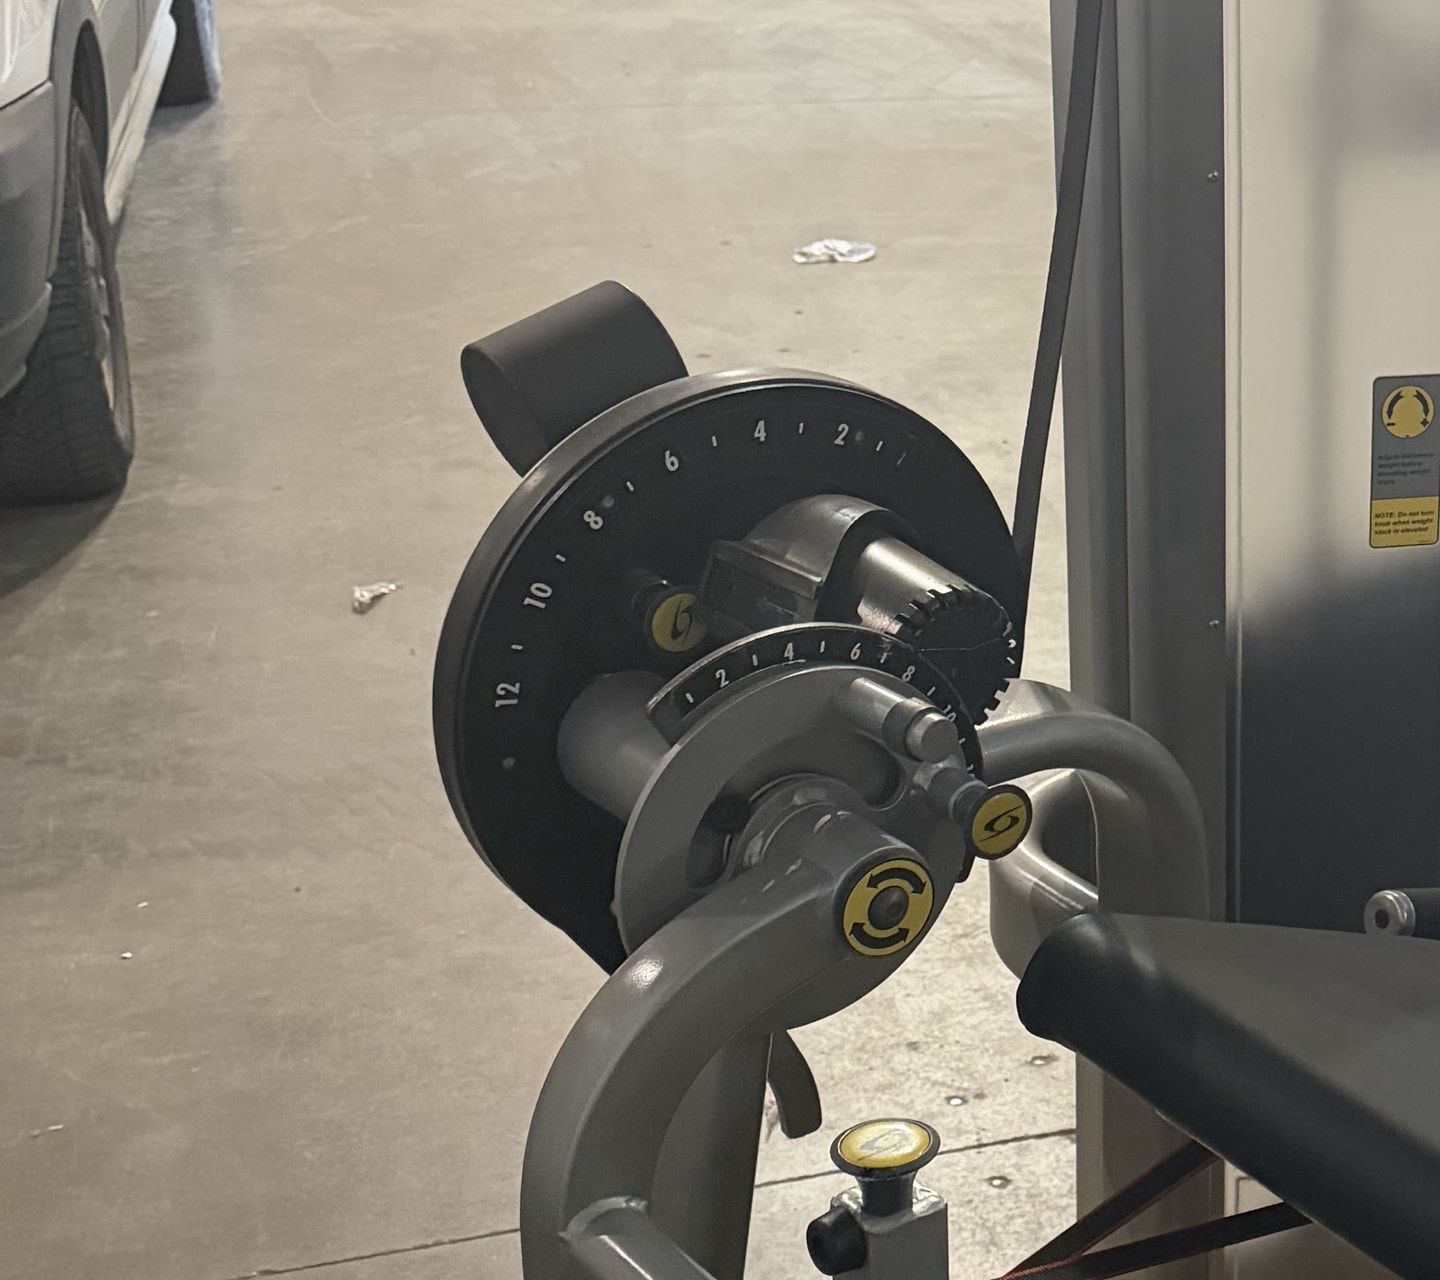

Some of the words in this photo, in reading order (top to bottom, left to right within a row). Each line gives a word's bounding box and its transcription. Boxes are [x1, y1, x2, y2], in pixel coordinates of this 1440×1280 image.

[494, 681, 521, 708] 12
[522, 581, 553, 610] 10
[583, 509, 604, 531] 8
[664, 449, 680, 472] 6
[753, 419, 767, 442] 4
[832, 423, 850, 446] 2
[714, 667, 730, 689] 2
[783, 642, 795, 660] 4
[850, 642, 861, 661] 6
[902, 665, 915, 683] 8
[942, 703, 958, 724] 10
